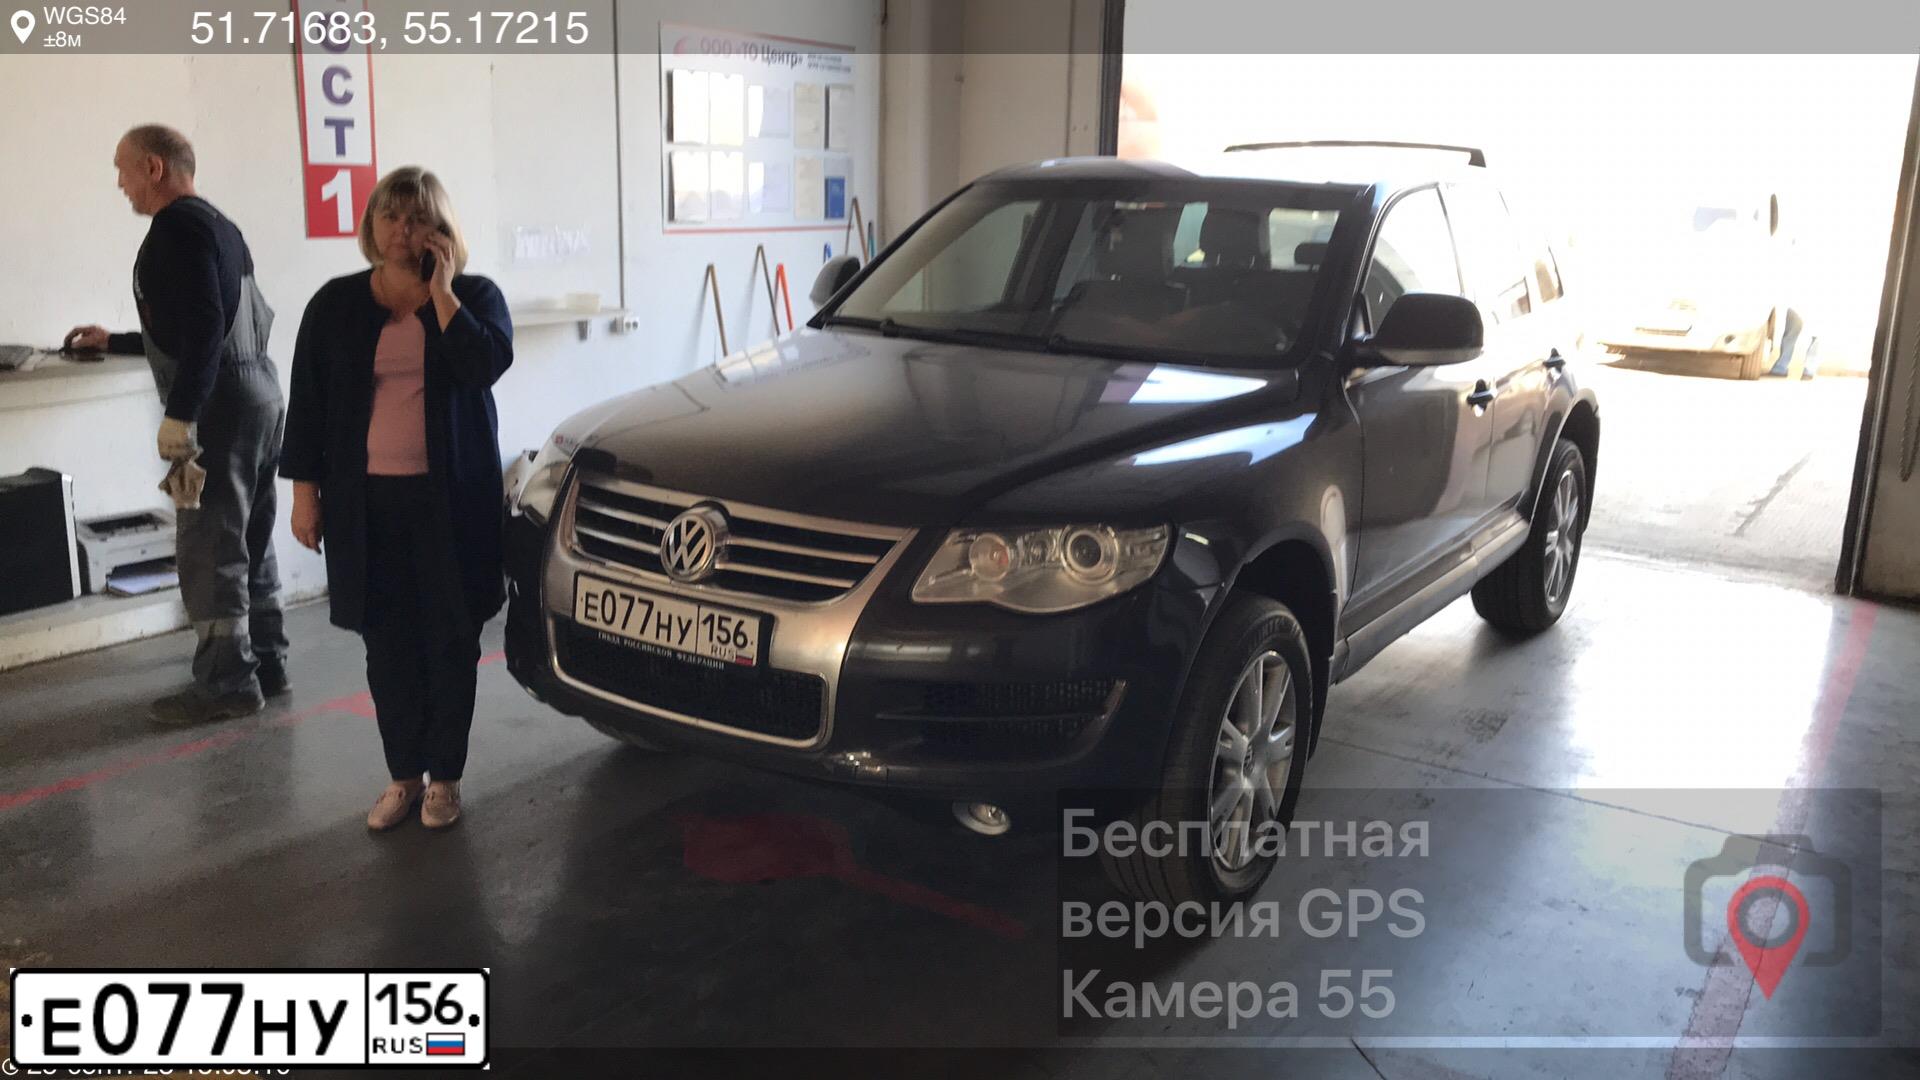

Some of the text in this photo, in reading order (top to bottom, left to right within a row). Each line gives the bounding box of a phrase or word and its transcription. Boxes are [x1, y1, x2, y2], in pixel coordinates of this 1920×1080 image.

[319, 0, 356, 233] ОСТ 1
[583, 588, 749, 649] Е077НУ 156
[710, 644, 737, 661] RUS
